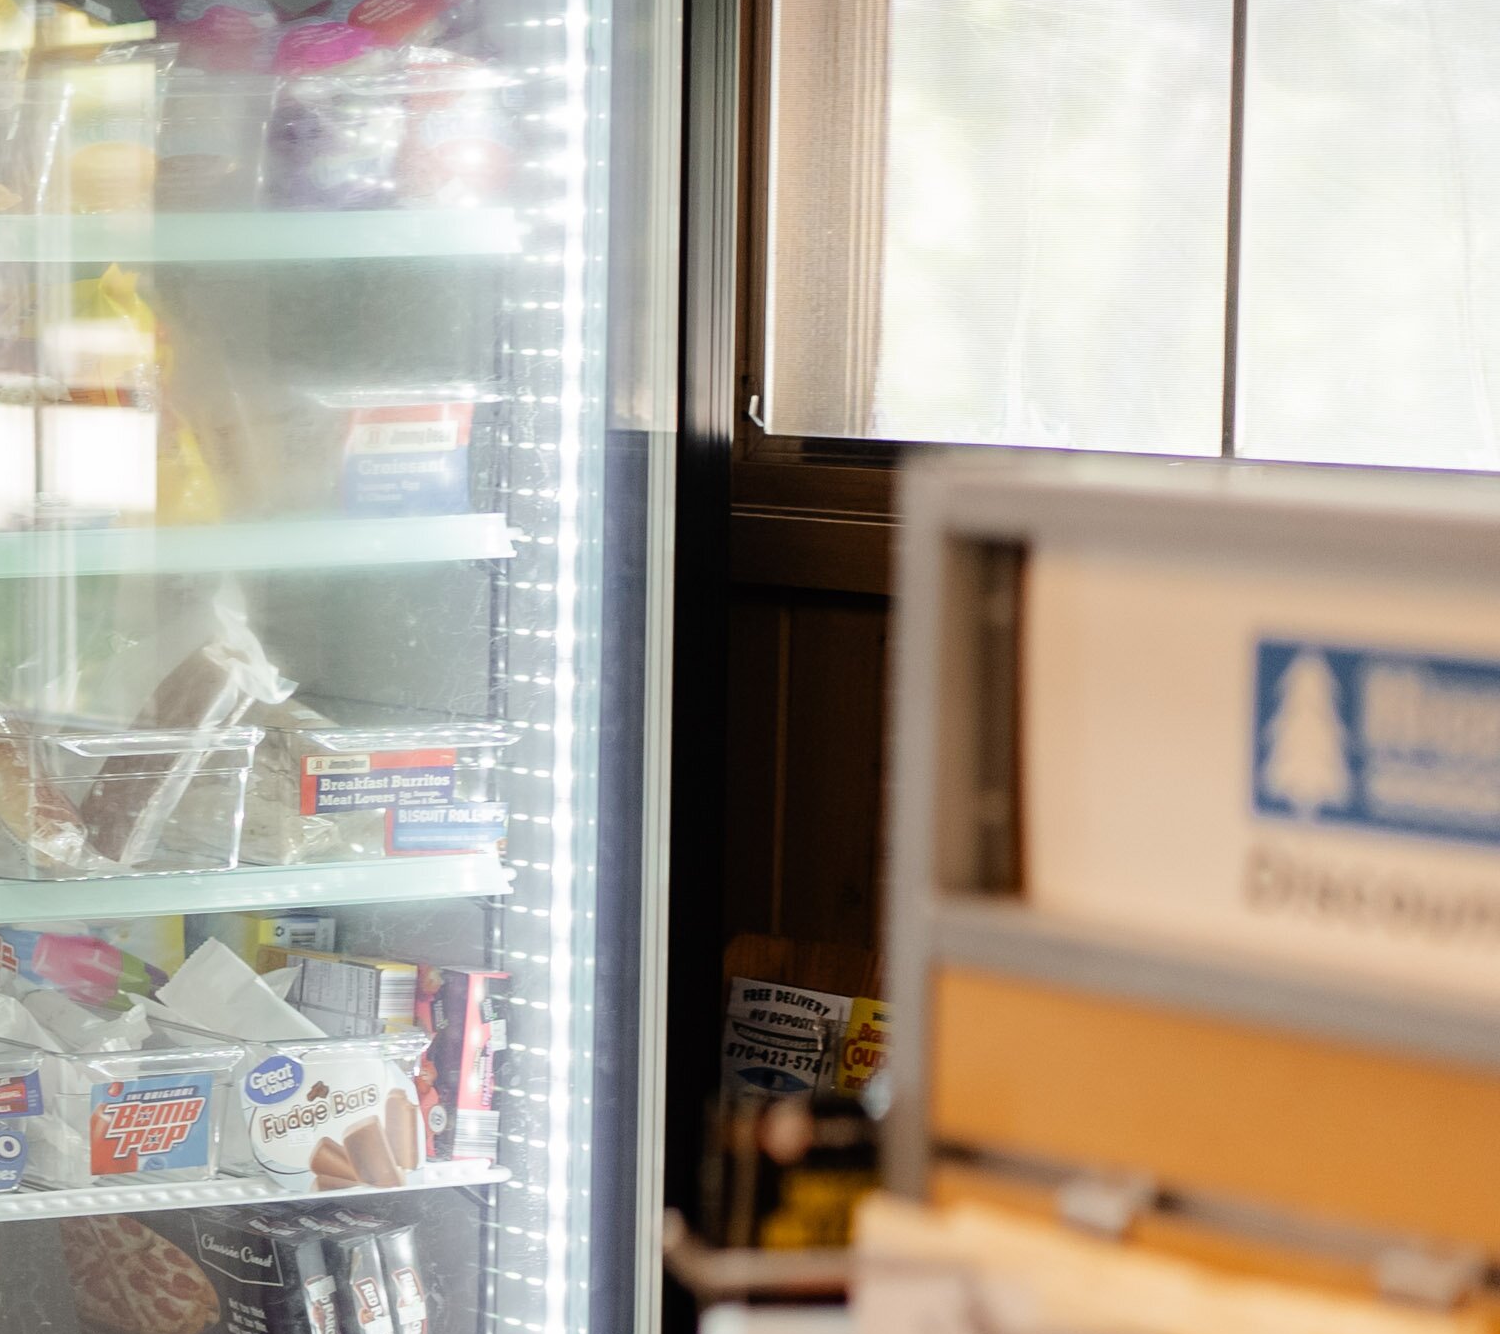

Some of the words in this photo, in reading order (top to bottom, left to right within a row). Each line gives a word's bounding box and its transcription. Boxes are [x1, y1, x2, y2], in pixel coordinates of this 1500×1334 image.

[357, 457, 445, 475] Croissant
[320, 775, 390, 791] Breakfast
[391, 773, 451, 788] Burritos
[319, 794, 353, 807] Meat
[355, 792, 396, 805] Lovers
[397, 809, 446, 823] BISCUIT
[743, 988, 772, 1003] FREE
[775, 990, 831, 1017] DELIVERY
[749, 1008, 766, 1022] NO
[250, 1062, 294, 1090] Great
[143, 1087, 195, 1100] ORIGINAL
[261, 1078, 296, 1097] Value
[112, 1099, 202, 1128] BOMB
[261, 1101, 327, 1142] Fudge
[333, 1085, 378, 1116] Bars
[119, 1123, 189, 1155] POP
[200, 1234, 240, 1259] Classic
[241, 1248, 274, 1267] Crust
[362, 1283, 376, 1305] RED
